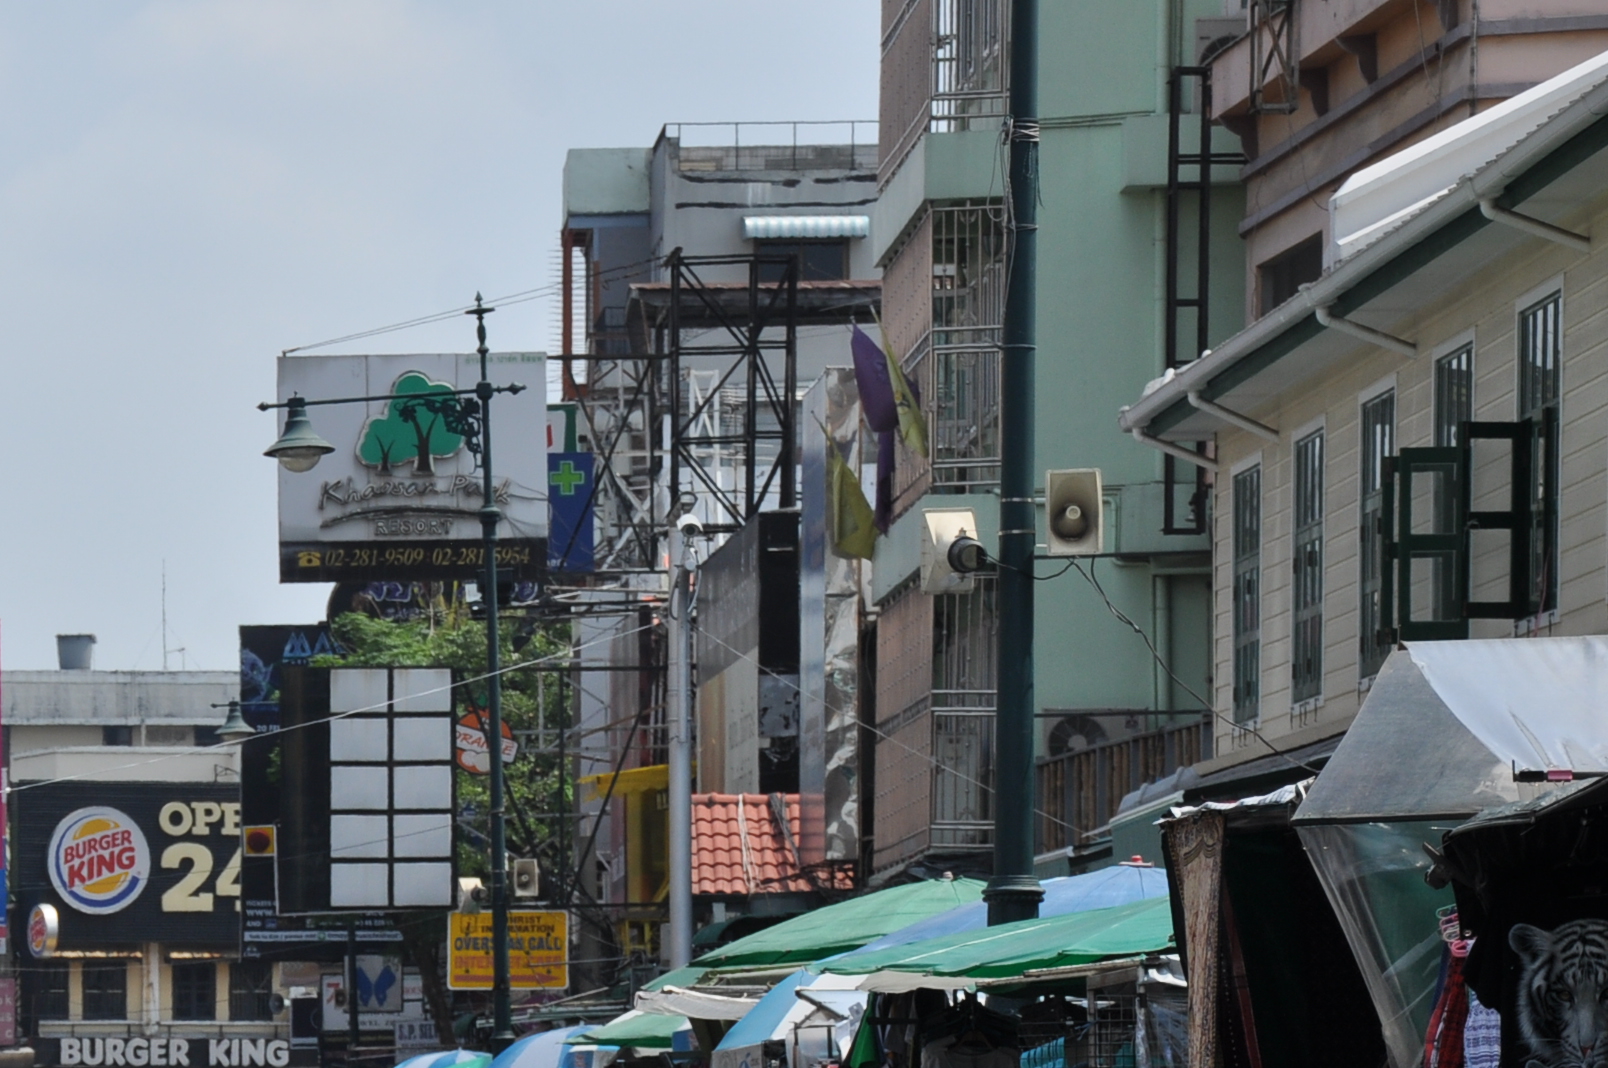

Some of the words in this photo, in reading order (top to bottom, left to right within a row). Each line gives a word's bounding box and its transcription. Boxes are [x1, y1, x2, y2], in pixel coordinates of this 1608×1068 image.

[450, 476, 510, 503] Pak
[375, 519, 453, 536] RESORT
[432, 548, 530, 565] 02-2815954
[63, 829, 132, 865] BURGER
[68, 847, 136, 890] KING
[454, 936, 523, 951] OVERSAS
[528, 937, 562, 951] CALL
[60, 1038, 190, 1067] BURGER
[208, 1039, 290, 1067] KING
